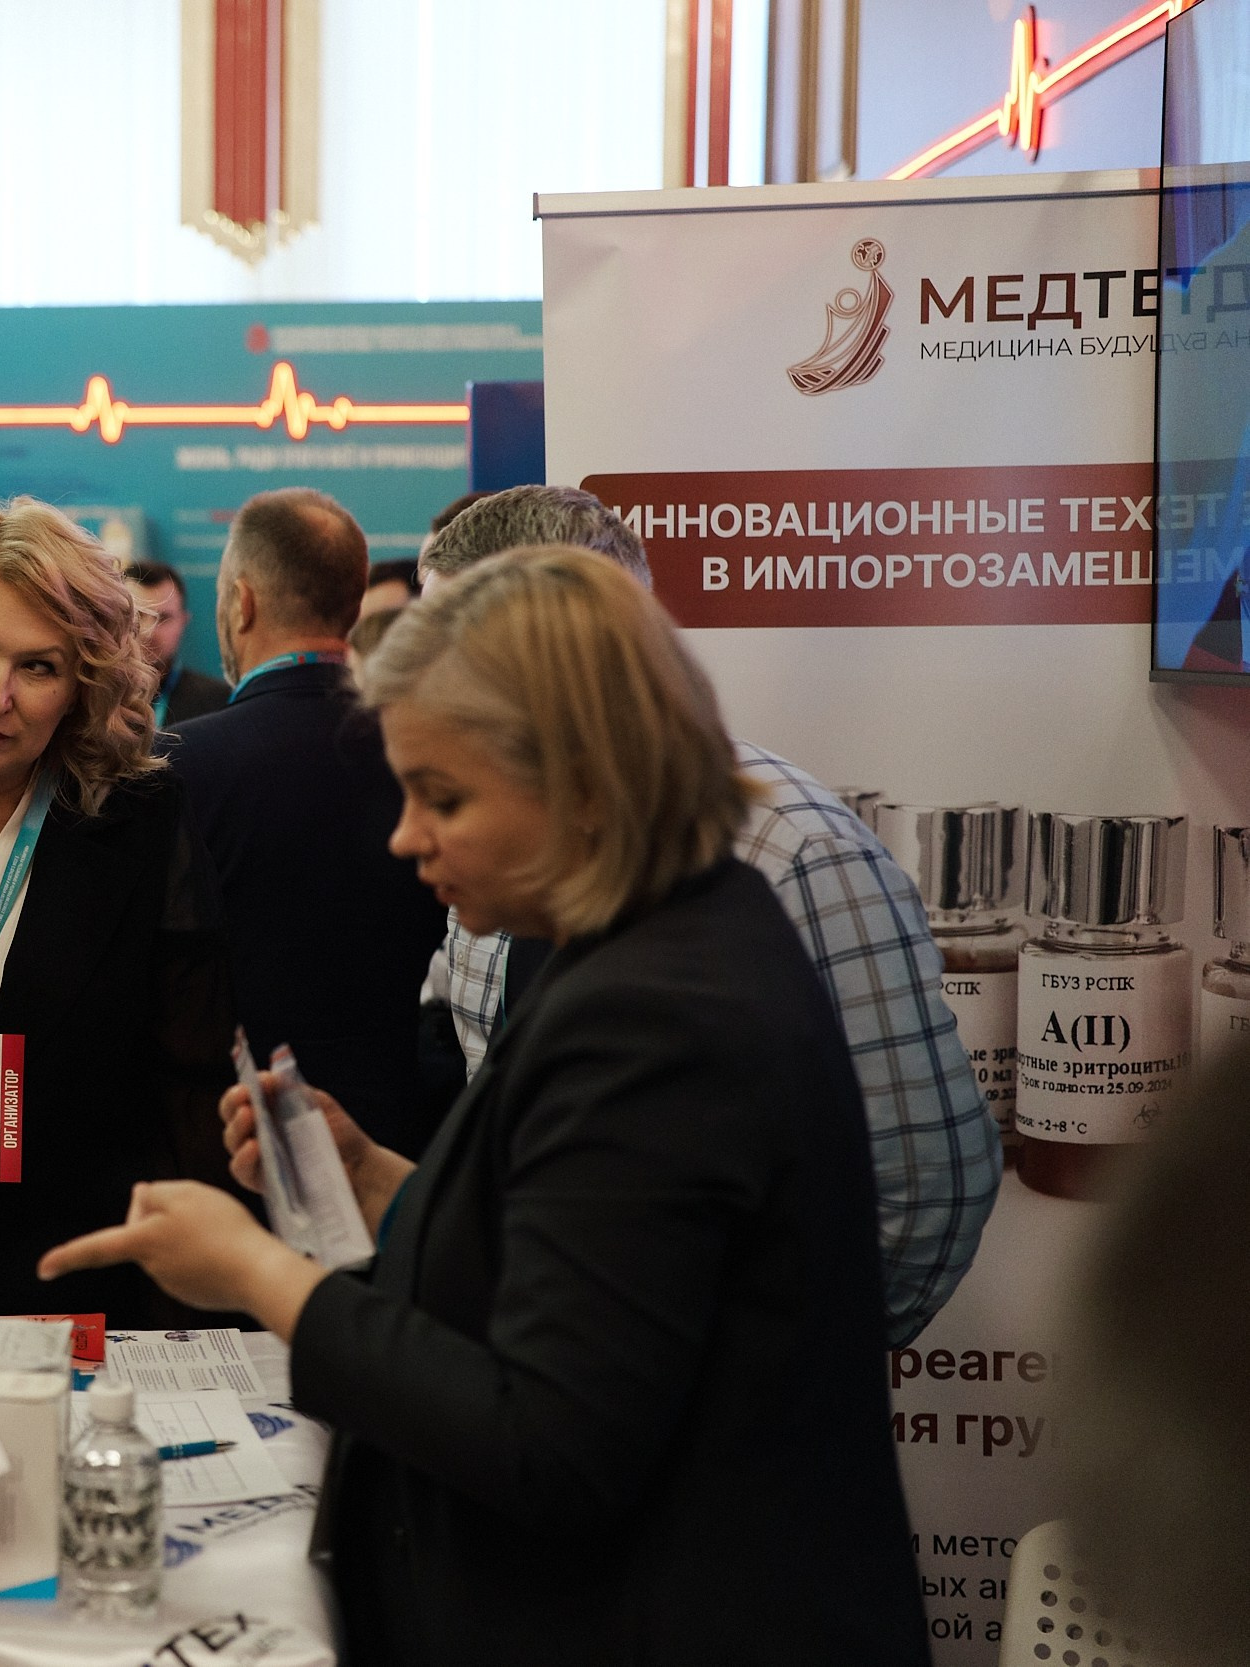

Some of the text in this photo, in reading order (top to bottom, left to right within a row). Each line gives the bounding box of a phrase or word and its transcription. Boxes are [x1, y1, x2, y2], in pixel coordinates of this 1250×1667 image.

[920, 337, 1073, 362] МЕДИЦИНА
[613, 496, 1044, 543] ИННОВАЦИОННЫЕ
[1060, 495, 1153, 532] ТЕХ
[702, 556, 730, 591] В
[1042, 974, 1135, 991] ГБУЗ РСПК
[1043, 1080, 1104, 1095] годности
[4, 1069, 19, 1149] ОРГАНИЗАТОР
[925, 1612, 972, 1640] ой
